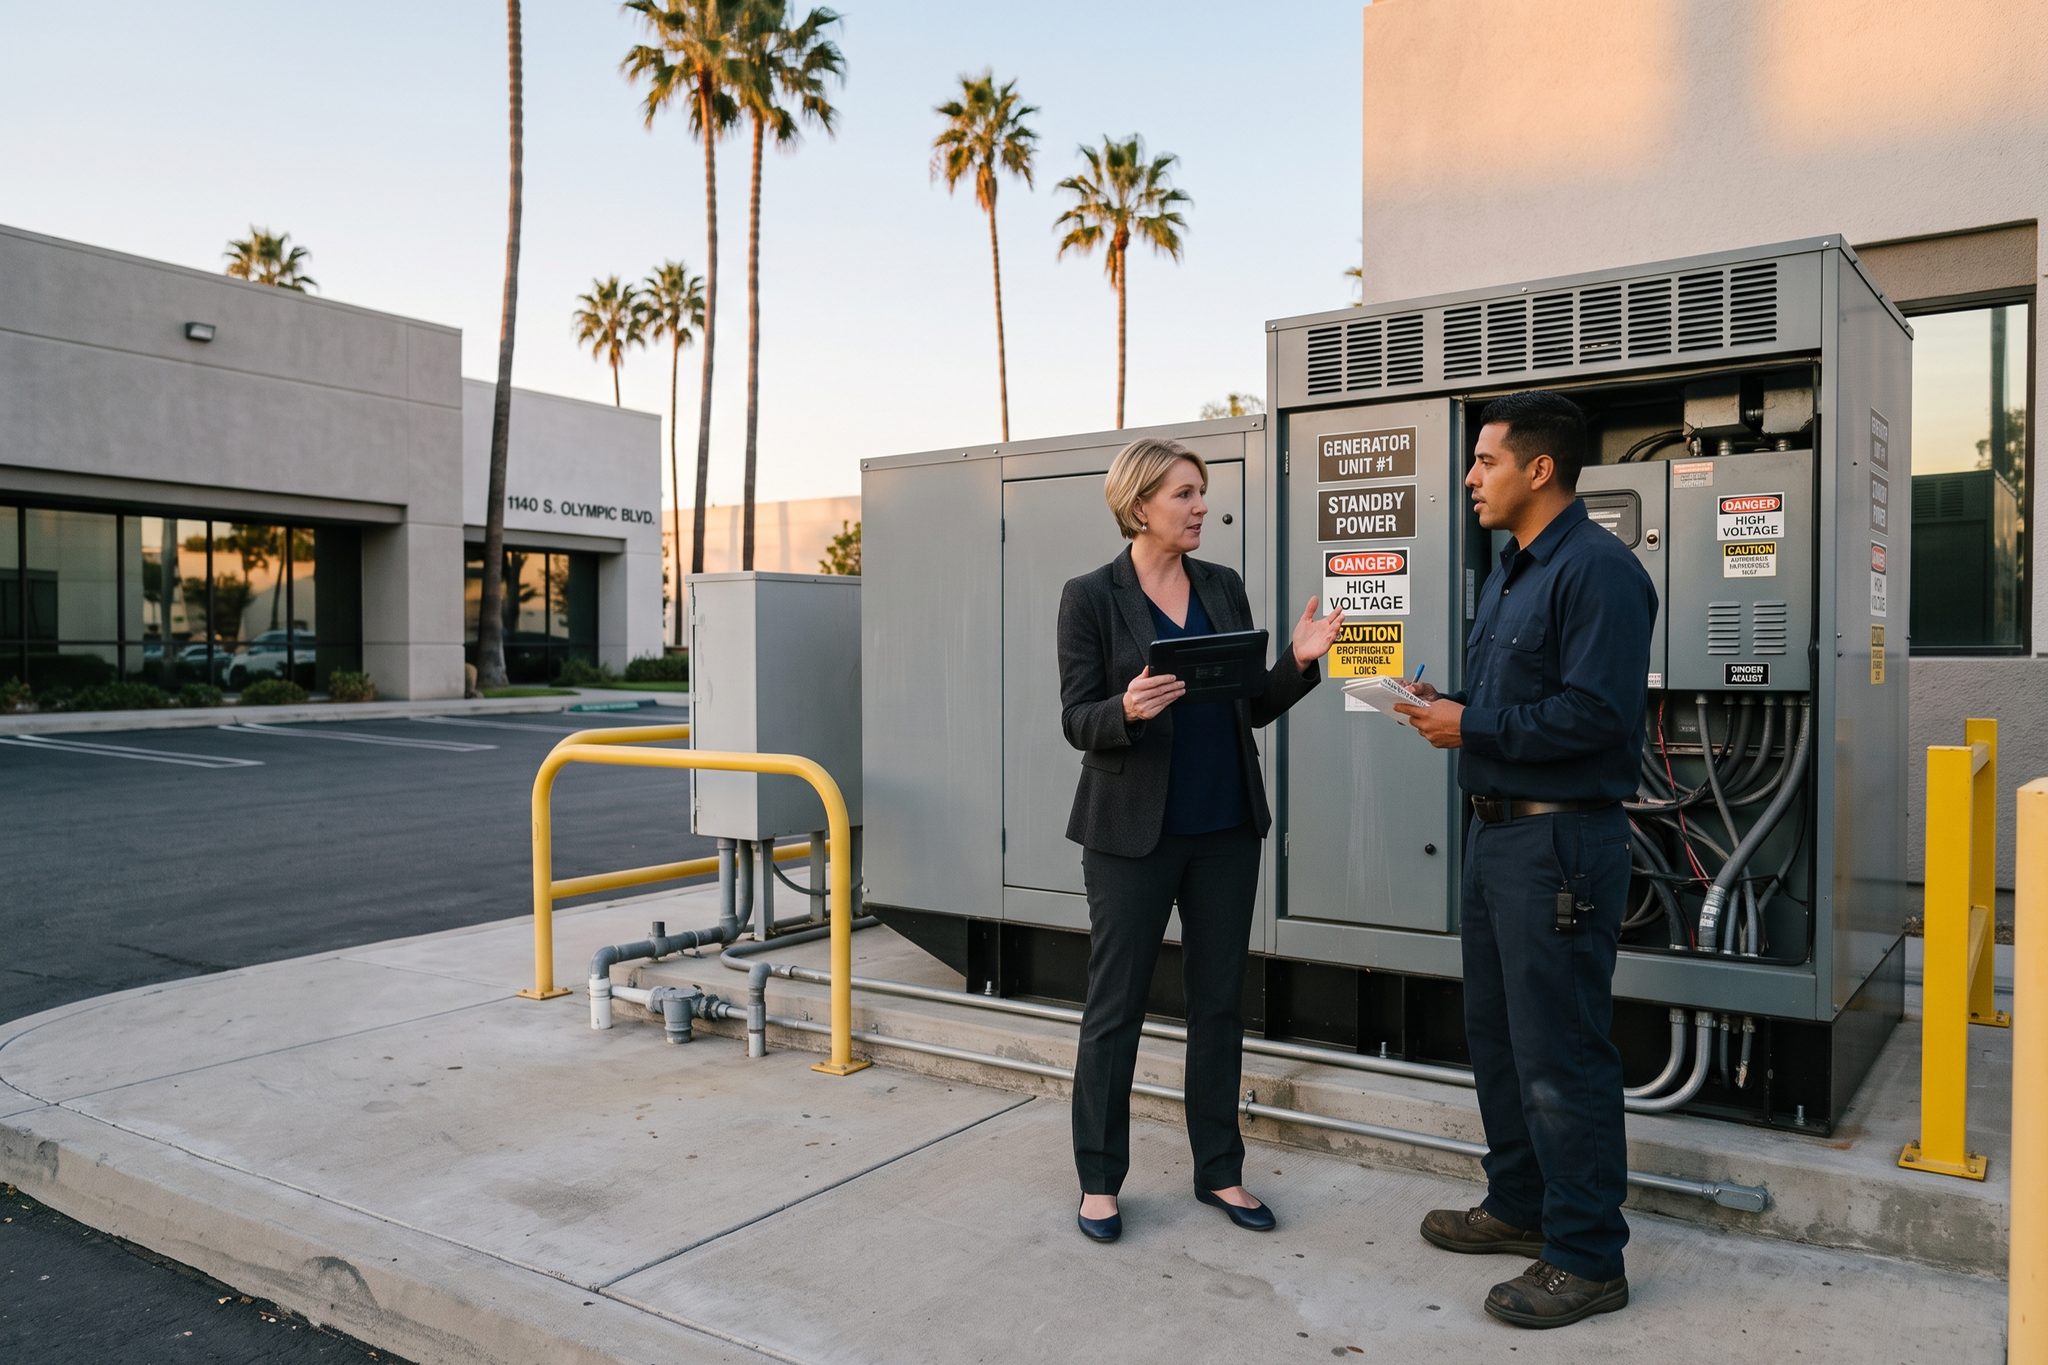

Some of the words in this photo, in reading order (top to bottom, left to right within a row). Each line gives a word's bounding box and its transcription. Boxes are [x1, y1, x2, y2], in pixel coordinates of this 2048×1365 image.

[1323, 434, 1410, 457] GENERATOR
[1338, 458, 1373, 475] UNIT
[1376, 455, 1393, 472] #1
[507, 495, 538, 512] 1140
[543, 499, 557, 514] S.
[560, 501, 617, 521] OLYMPIC
[621, 508, 656, 525] BLVD.
[1328, 491, 1405, 514] STANDBY
[1725, 499, 1776, 510] DANGER
[1336, 514, 1397, 535] POWER
[1735, 515, 1765, 525] HIGH
[1723, 525, 1779, 537] VOLTAGE
[1727, 544, 1774, 555] CAUTION
[1334, 556, 1397, 572] DANGER
[1346, 580, 1385, 594] HIGH
[1330, 595, 1403, 610] VOLTAGE
